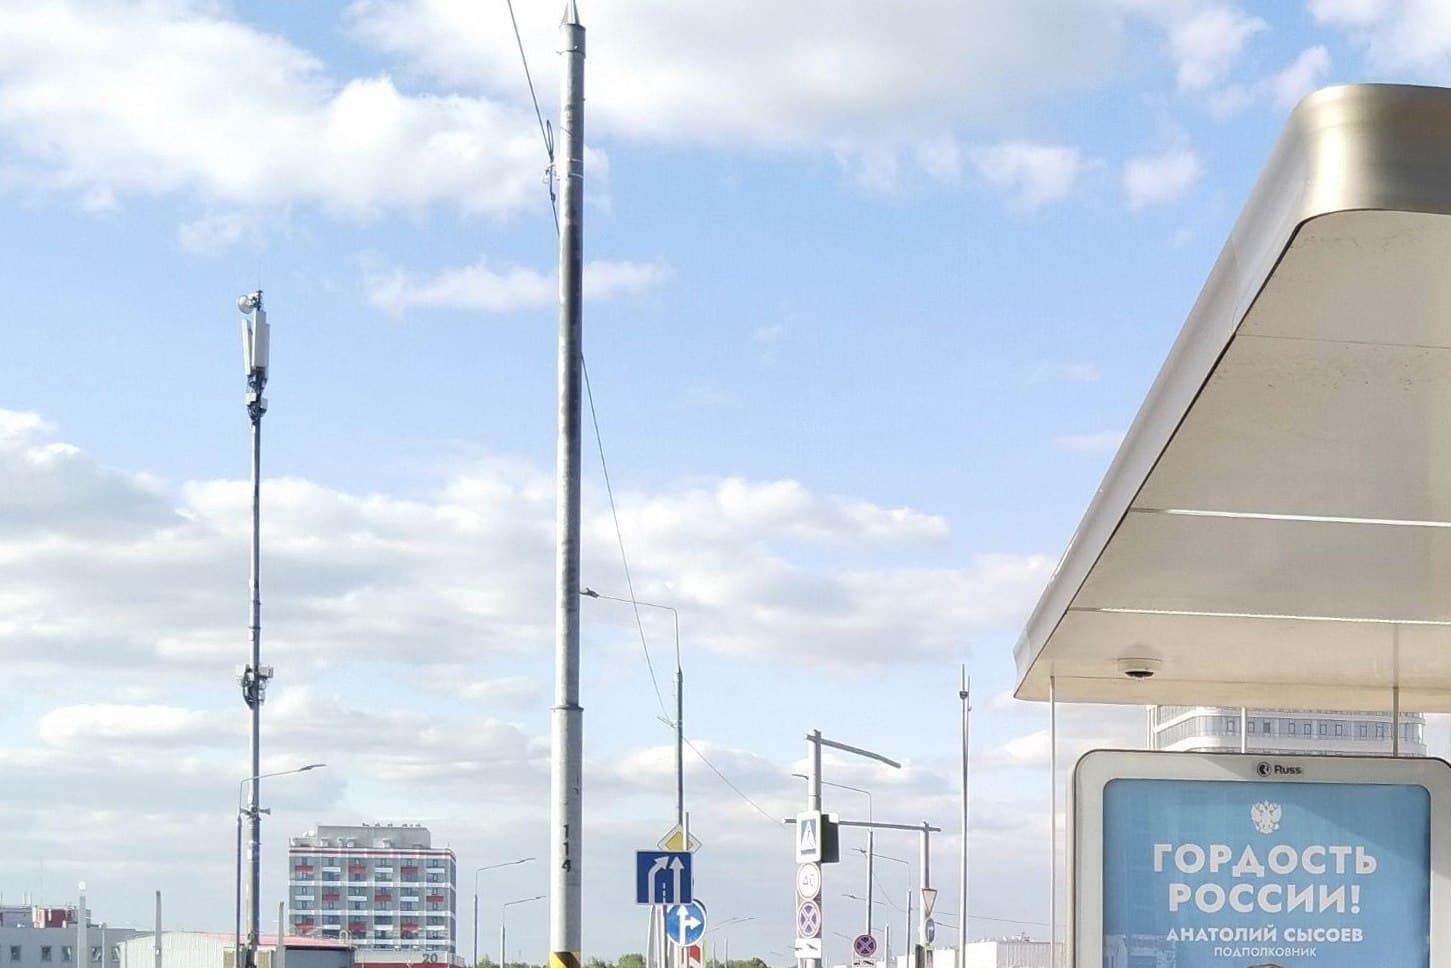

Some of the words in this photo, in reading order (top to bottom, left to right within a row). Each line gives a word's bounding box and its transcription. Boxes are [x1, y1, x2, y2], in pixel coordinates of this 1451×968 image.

[1274, 764, 1302, 775] Russ
[561, 823, 571, 872] 114
[1153, 843, 1377, 877] ГОРДОСТЬ
[1168, 883, 1361, 914] РОССИИ!
[1166, 924, 1277, 942] АНАТОЛИЙ
[1283, 927, 1364, 943] СЫСОЕВ
[422, 953, 438, 965] 20
[1214, 946, 1317, 958] ПОДПОЛКОВНИК
